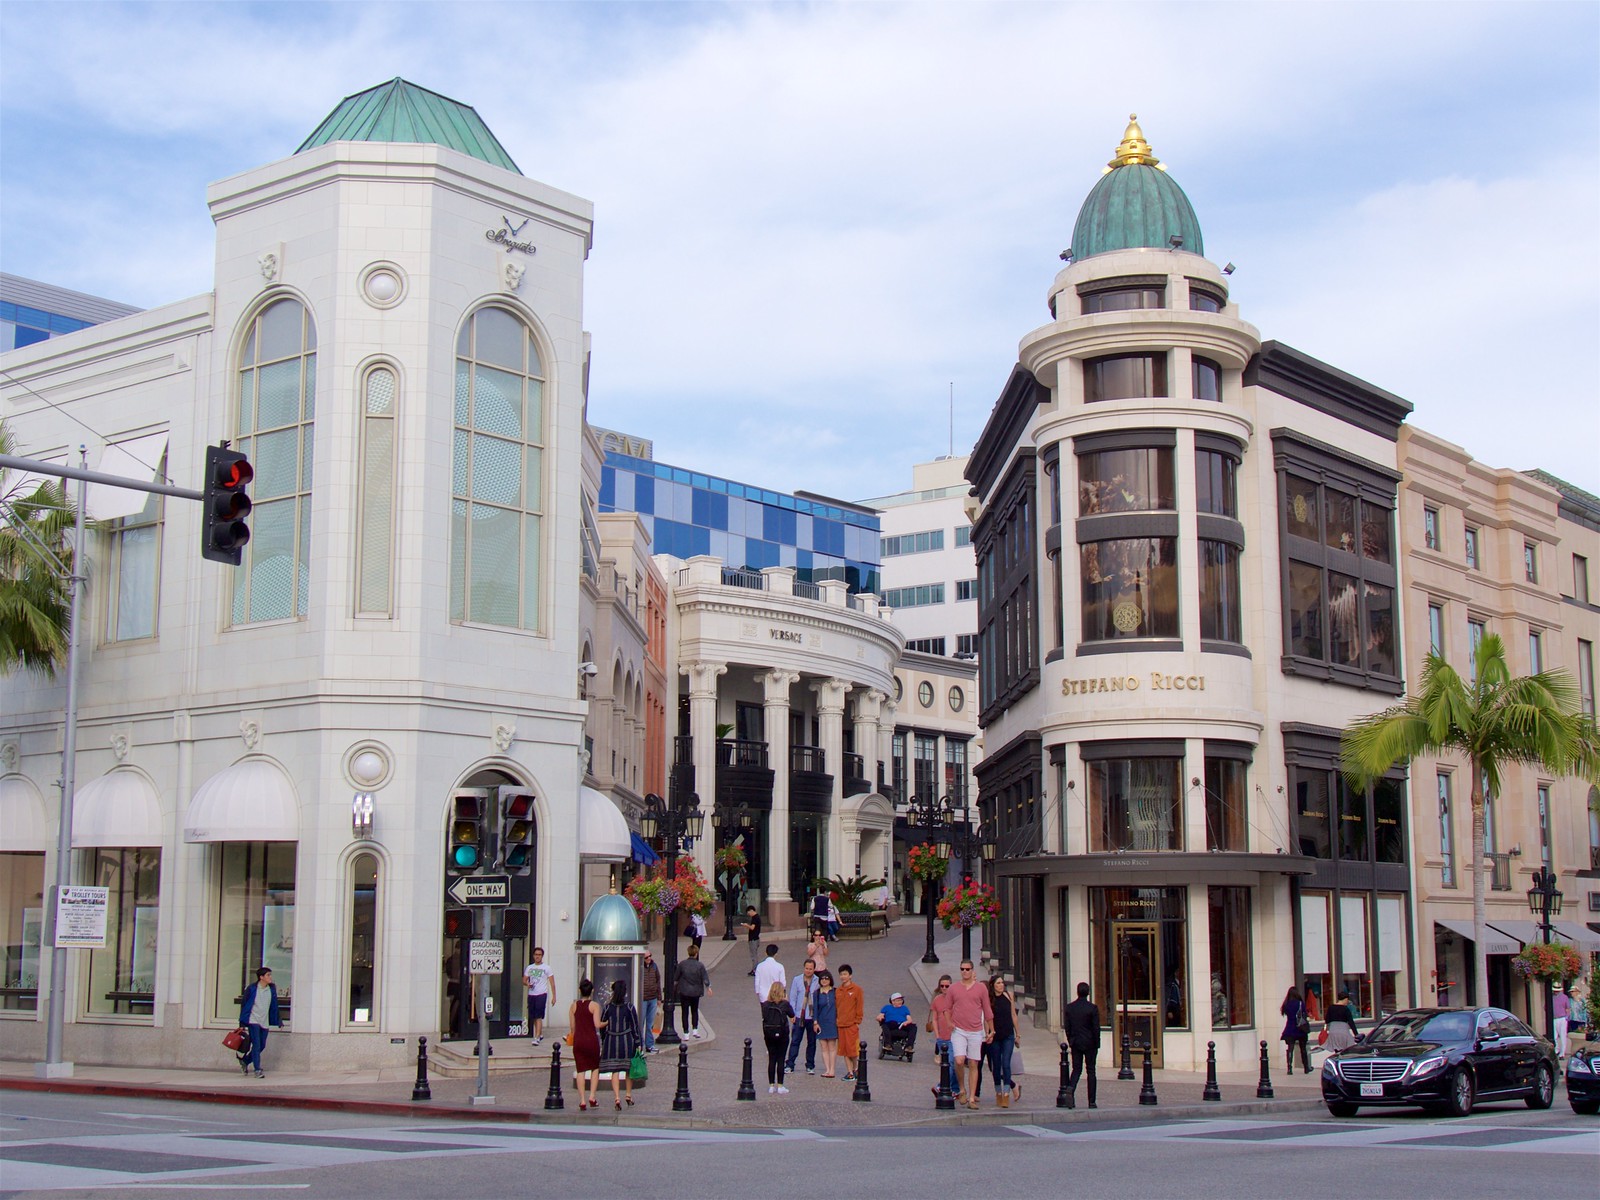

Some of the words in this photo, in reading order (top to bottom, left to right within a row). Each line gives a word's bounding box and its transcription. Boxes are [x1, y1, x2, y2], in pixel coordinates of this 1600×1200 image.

[769, 628, 802, 644] VERSACE
[71, 891, 91, 899] TROLLEY
[466, 885, 484, 896] ONE
[485, 885, 503, 895] WAY
[471, 959, 483, 970] OK
[509, 1025, 521, 1036] 280
